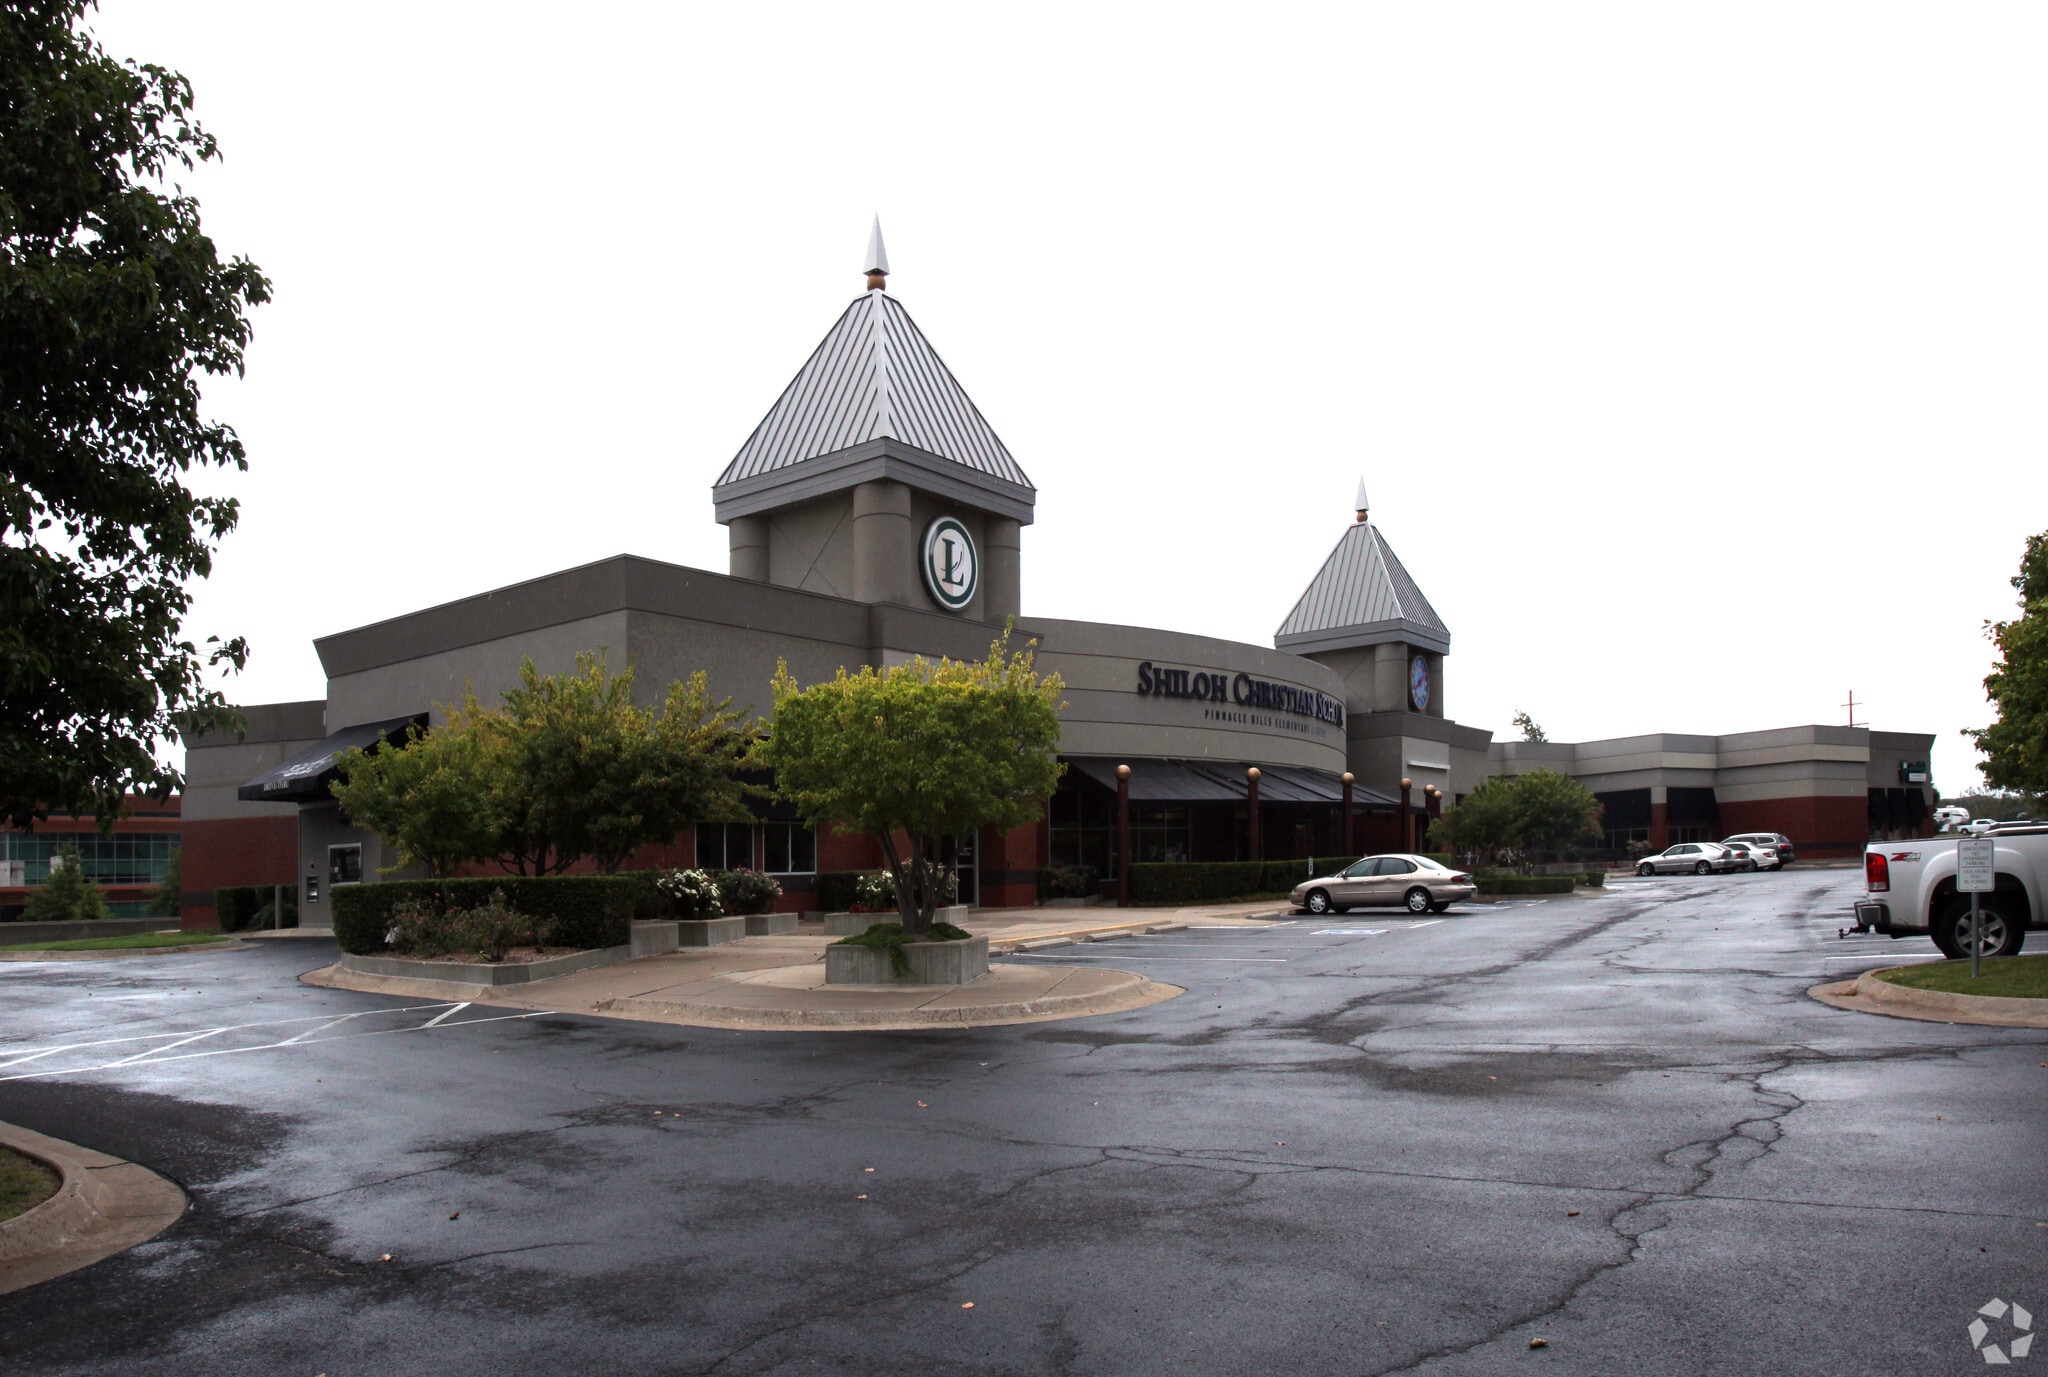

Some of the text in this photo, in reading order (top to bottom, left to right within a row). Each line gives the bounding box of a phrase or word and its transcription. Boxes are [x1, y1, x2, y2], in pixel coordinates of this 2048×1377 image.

[941, 538, 964, 587] L
[1138, 661, 1228, 702] SHILOH
[1233, 672, 1315, 716] CHRISTIAN
[1204, 709, 1247, 724] PINNACLE
[1251, 714, 1272, 727] HILLS
